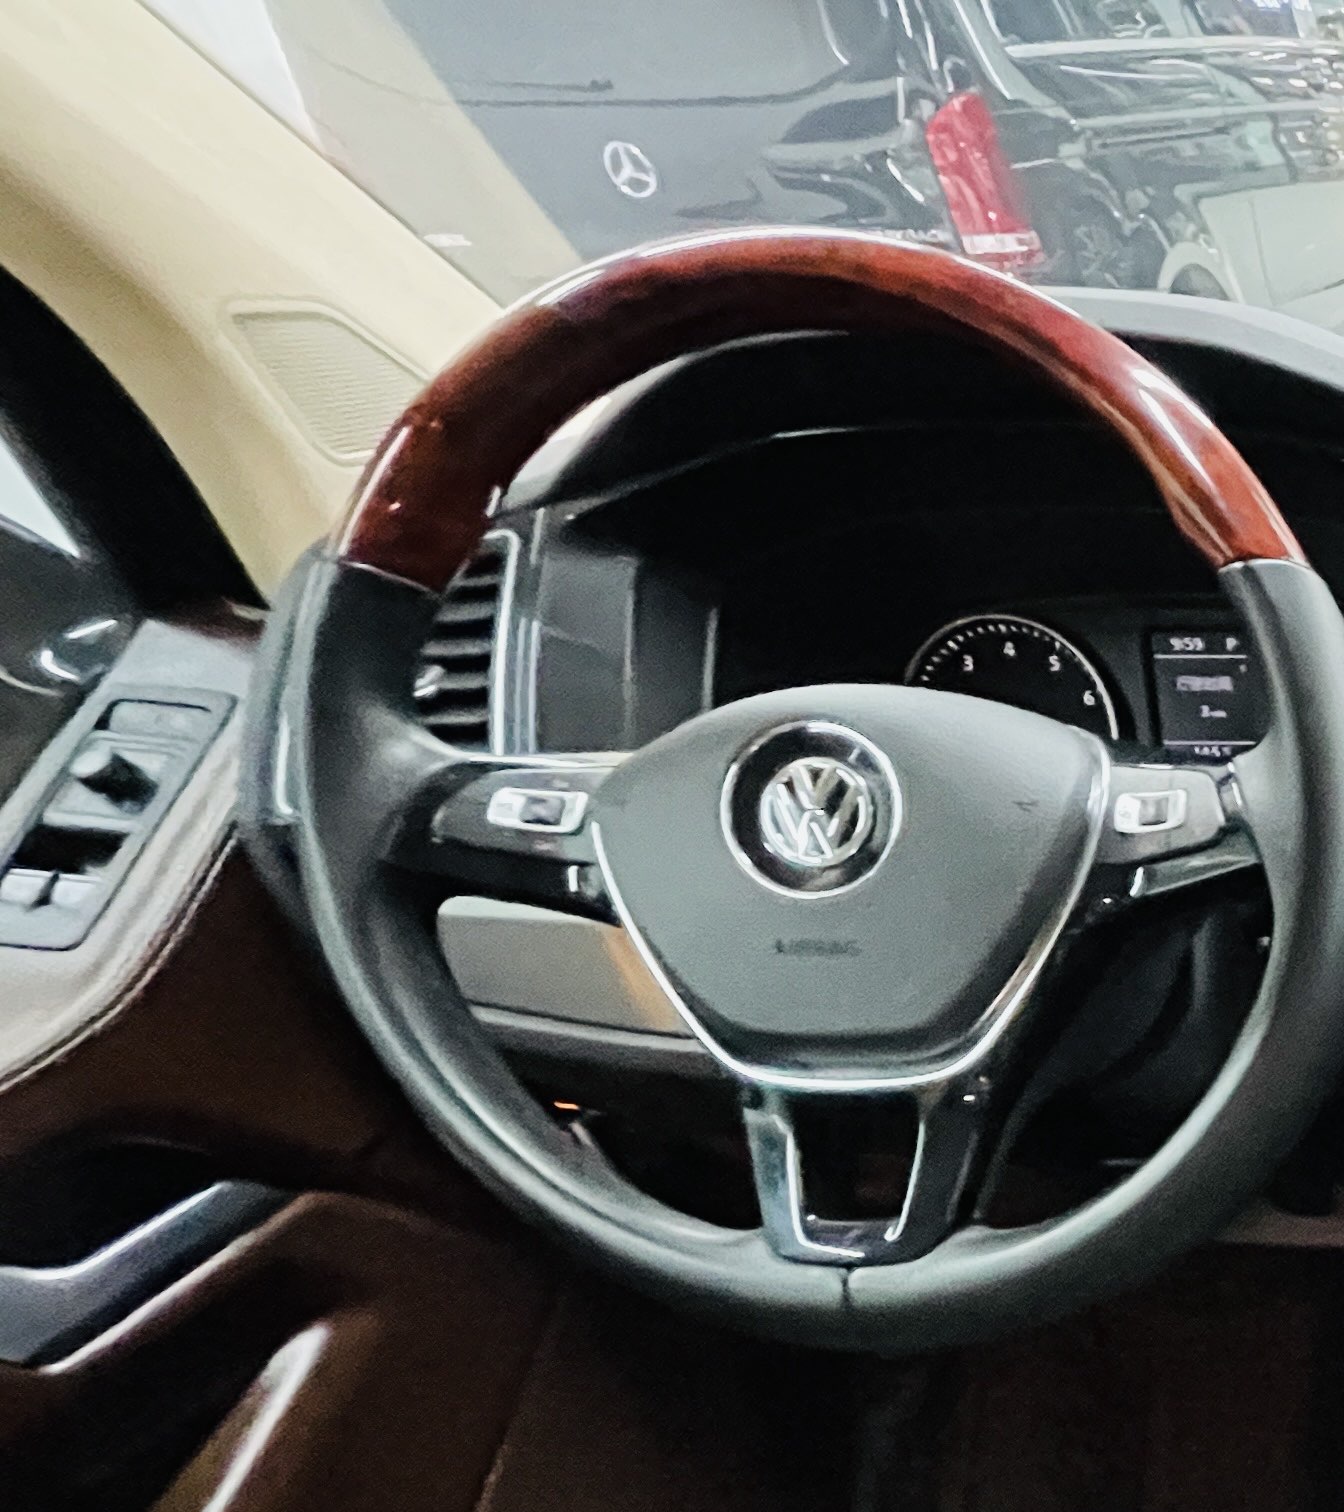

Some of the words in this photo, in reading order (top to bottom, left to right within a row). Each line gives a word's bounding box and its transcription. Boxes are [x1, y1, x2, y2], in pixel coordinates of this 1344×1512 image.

[1003, 641, 1016, 657] 4
[962, 655, 974, 672] 3
[1049, 655, 1061, 672] 5
[1083, 690, 1096, 706] 6
